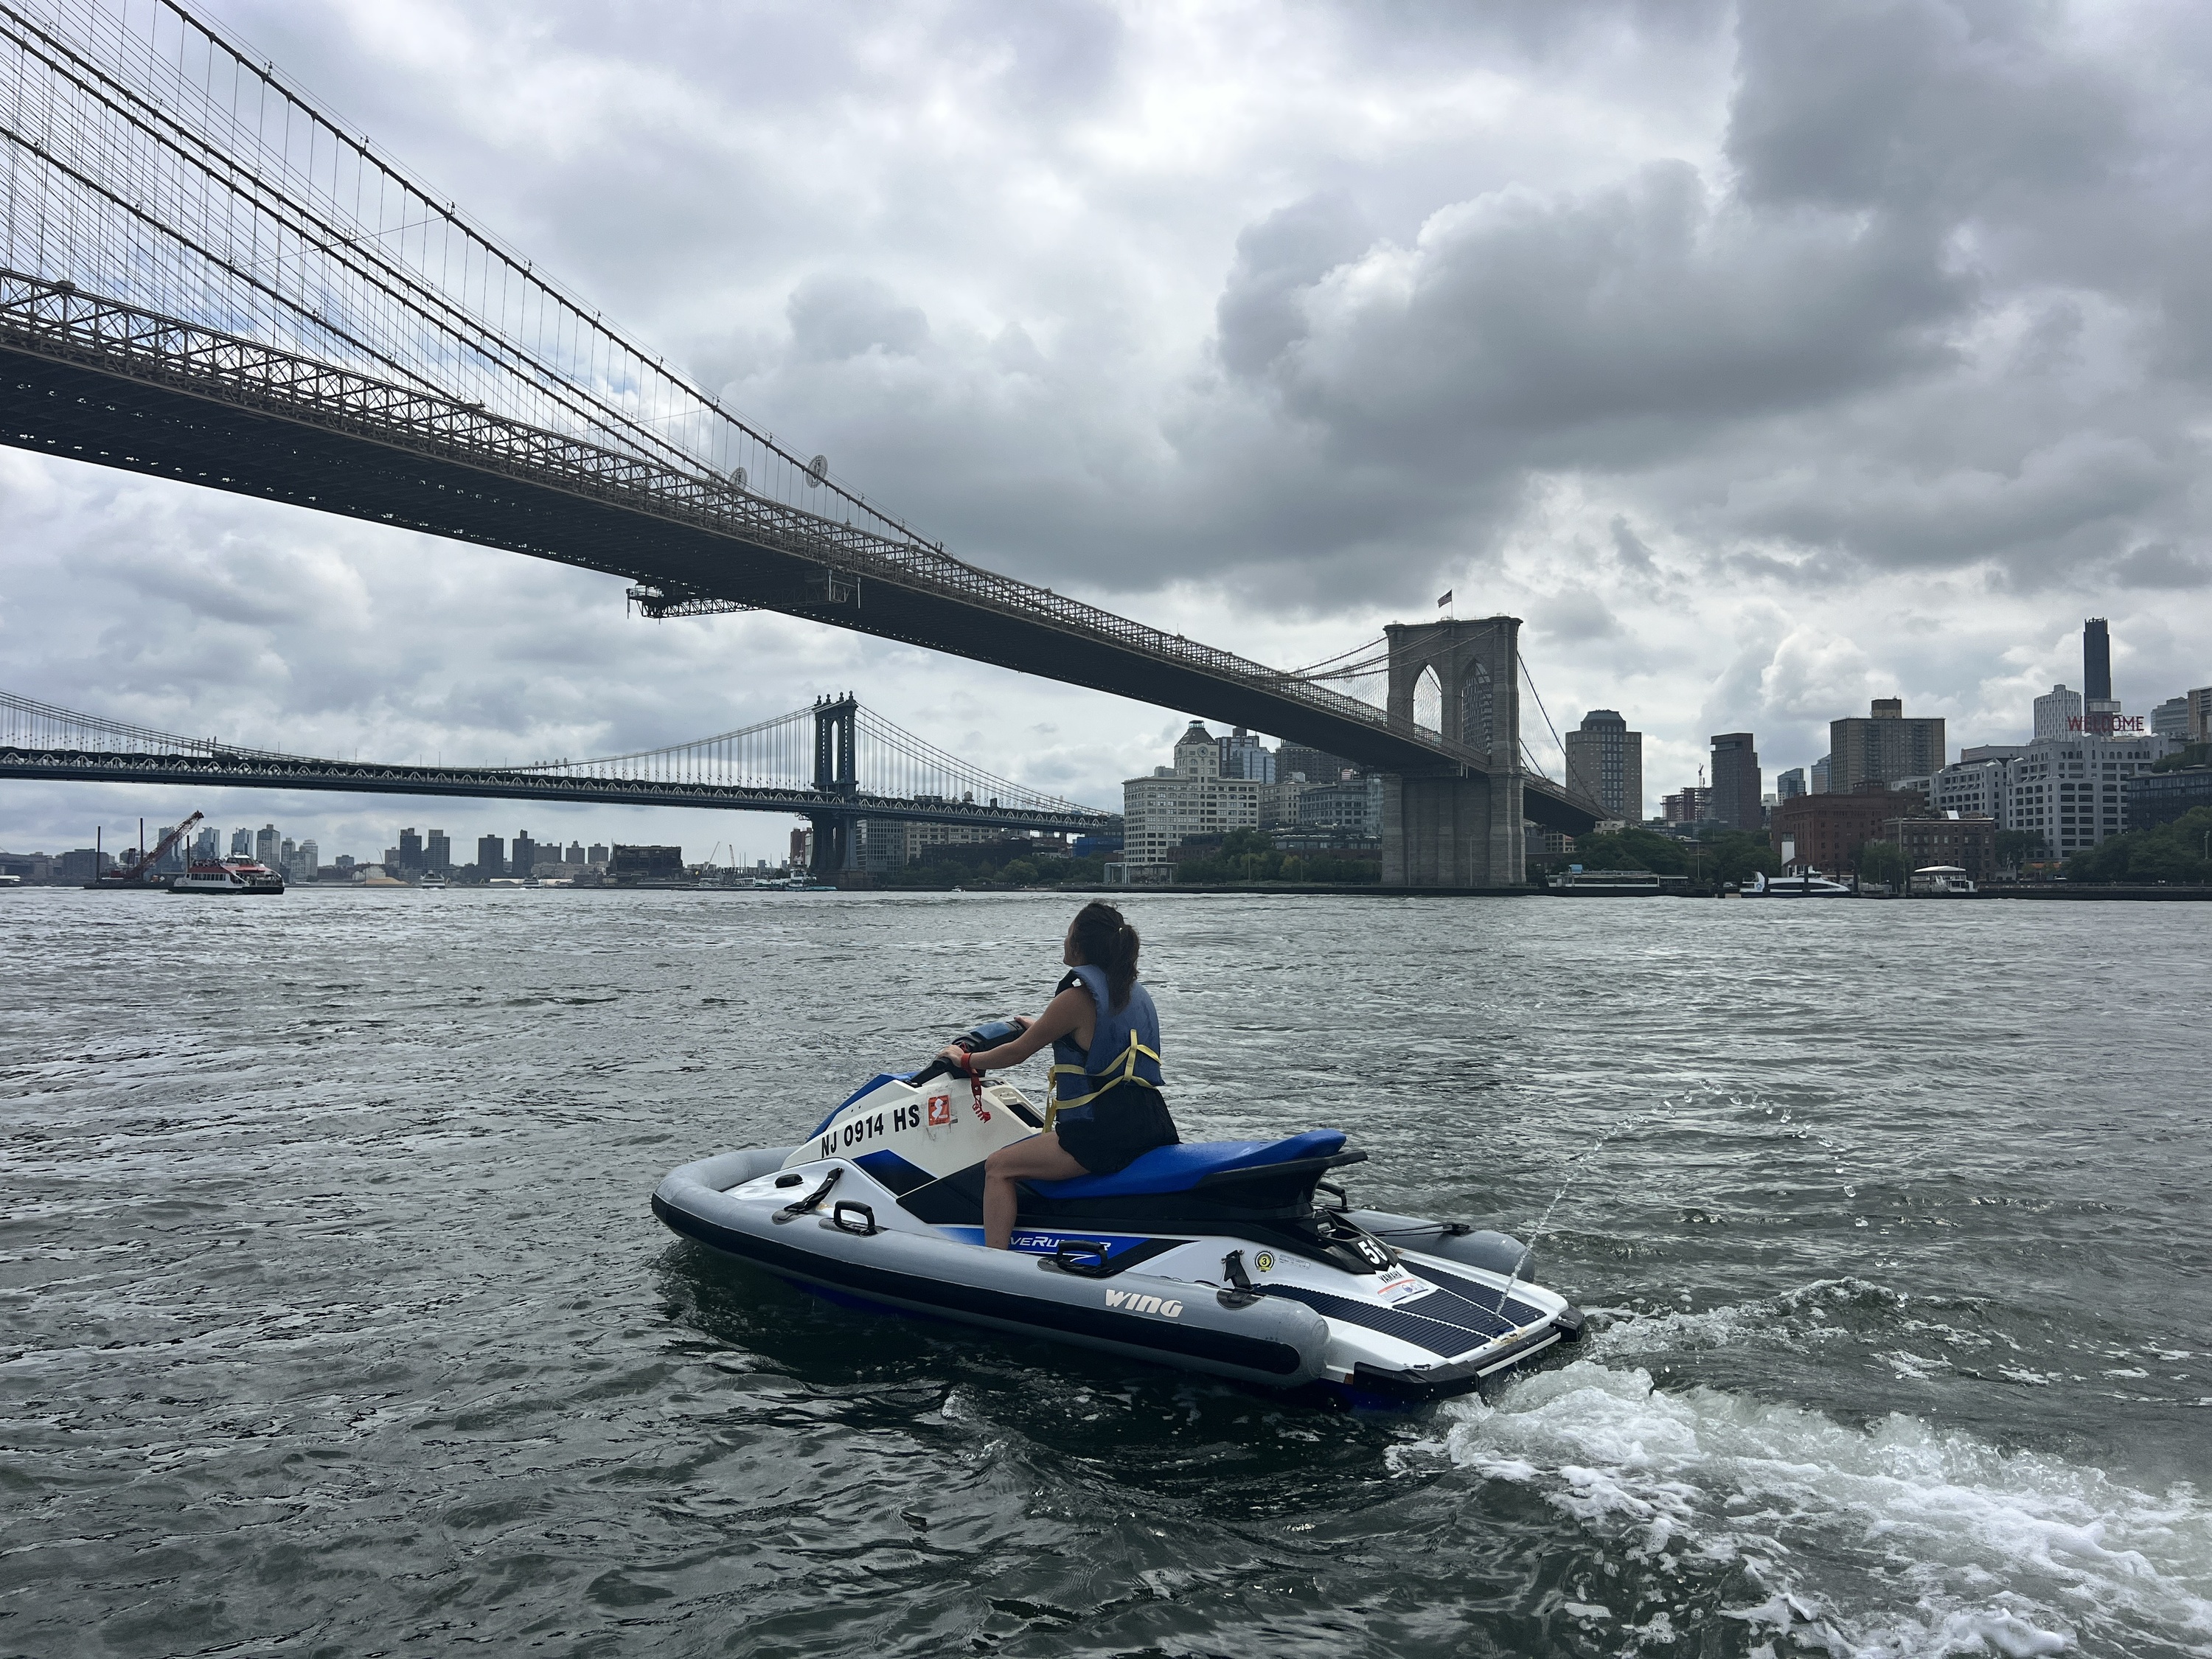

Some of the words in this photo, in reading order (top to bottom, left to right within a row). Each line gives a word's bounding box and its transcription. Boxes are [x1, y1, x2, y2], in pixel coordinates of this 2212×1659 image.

[2067, 716, 2144, 731] WELCOME
[821, 1131, 837, 1158] NJ
[844, 1113, 884, 1147] 0914
[894, 1105, 920, 1133] HS
[1262, 1257, 1267, 1265] 3
[1357, 1239, 1388, 1265] 56
[1377, 1270, 1404, 1284] YAMAHA
[1106, 1289, 1183, 1318] WING
